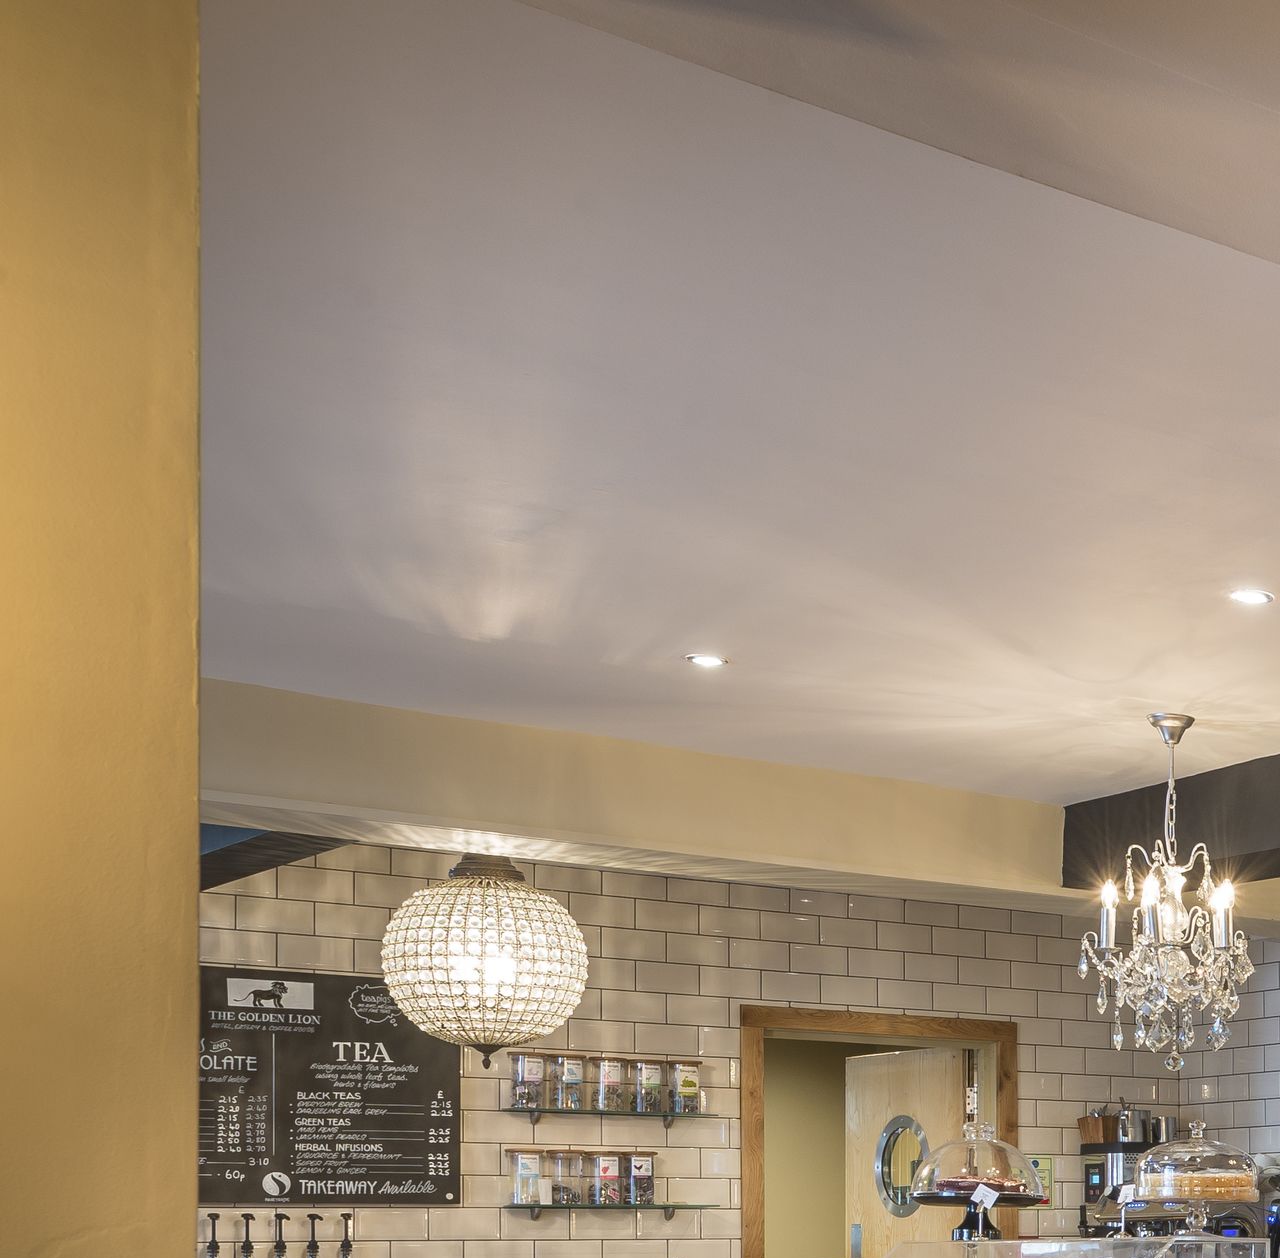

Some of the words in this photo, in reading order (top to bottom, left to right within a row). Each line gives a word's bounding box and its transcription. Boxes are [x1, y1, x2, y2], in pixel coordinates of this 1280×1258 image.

[208, 1010, 236, 1021] THE
[238, 1011, 285, 1023] GOLDEN
[289, 1013, 321, 1025] LION
[332, 1041, 394, 1063] TEA
[297, 1091, 330, 1100] BLACK
[332, 1092, 362, 1100] TEAS
[437, 1090, 444, 1099] £
[294, 1117, 324, 1126] GREEN
[326, 1118, 351, 1126] TEAS
[295, 1143, 332, 1152] HERBAL
[335, 1143, 384, 1152] INFUSIONS
[225, 1169, 246, 1182] 60p
[299, 1179, 378, 1195] TAKEAWAY
[377, 1180, 438, 1195] Available
